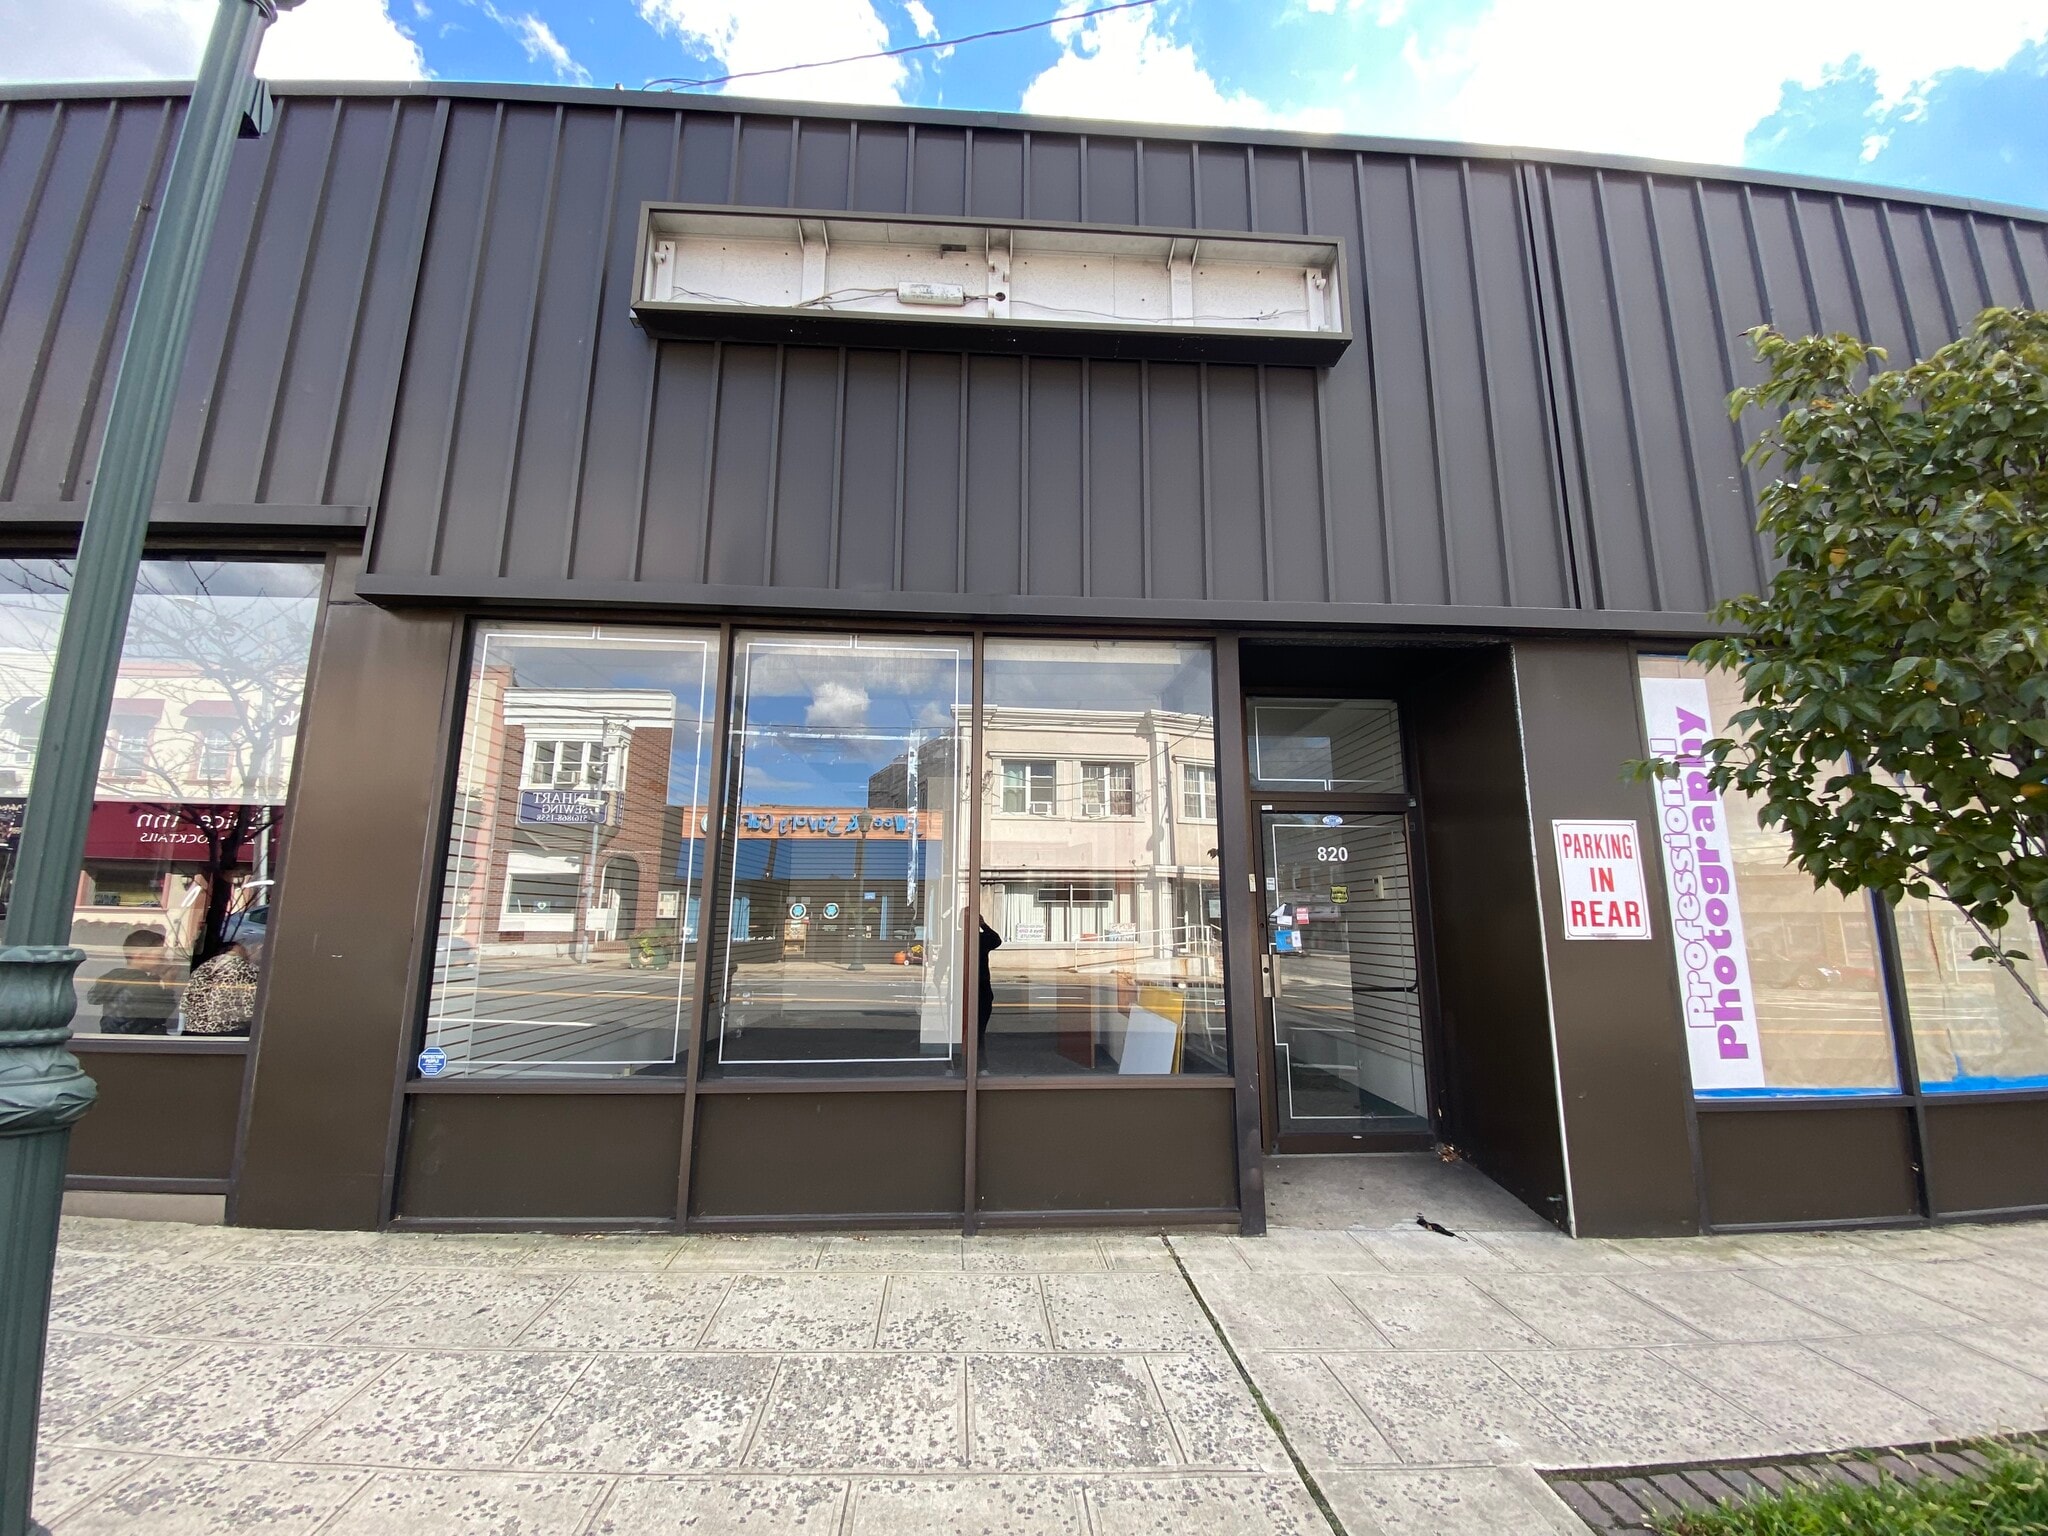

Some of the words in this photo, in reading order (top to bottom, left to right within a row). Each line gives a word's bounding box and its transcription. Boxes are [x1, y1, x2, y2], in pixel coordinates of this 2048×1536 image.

[1317, 846, 1348, 862] 820
[1562, 833, 1633, 859] PARKING
[1589, 867, 1615, 892] IN
[1650, 738, 1718, 1029] Professionl
[1676, 706, 1749, 1060] Photography
[1571, 900, 1641, 927] REAR
